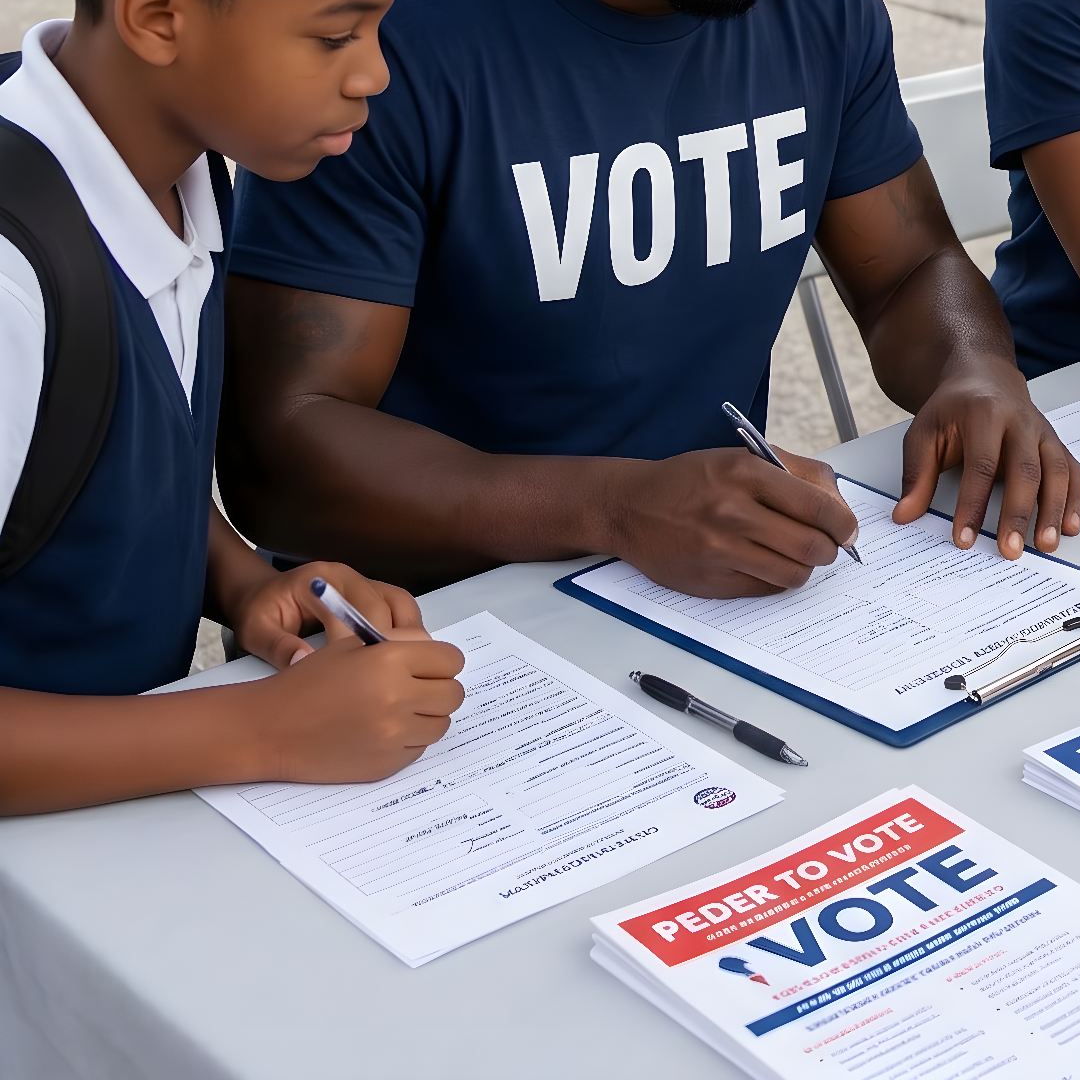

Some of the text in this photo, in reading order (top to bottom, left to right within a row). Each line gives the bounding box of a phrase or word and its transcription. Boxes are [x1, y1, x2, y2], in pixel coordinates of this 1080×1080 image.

[511, 106, 806, 302] VOTE
[651, 883, 779, 943] PEDER
[773, 860, 824, 891] TO
[825, 812, 926, 863] VOTE
[746, 844, 999, 968] VOTE
